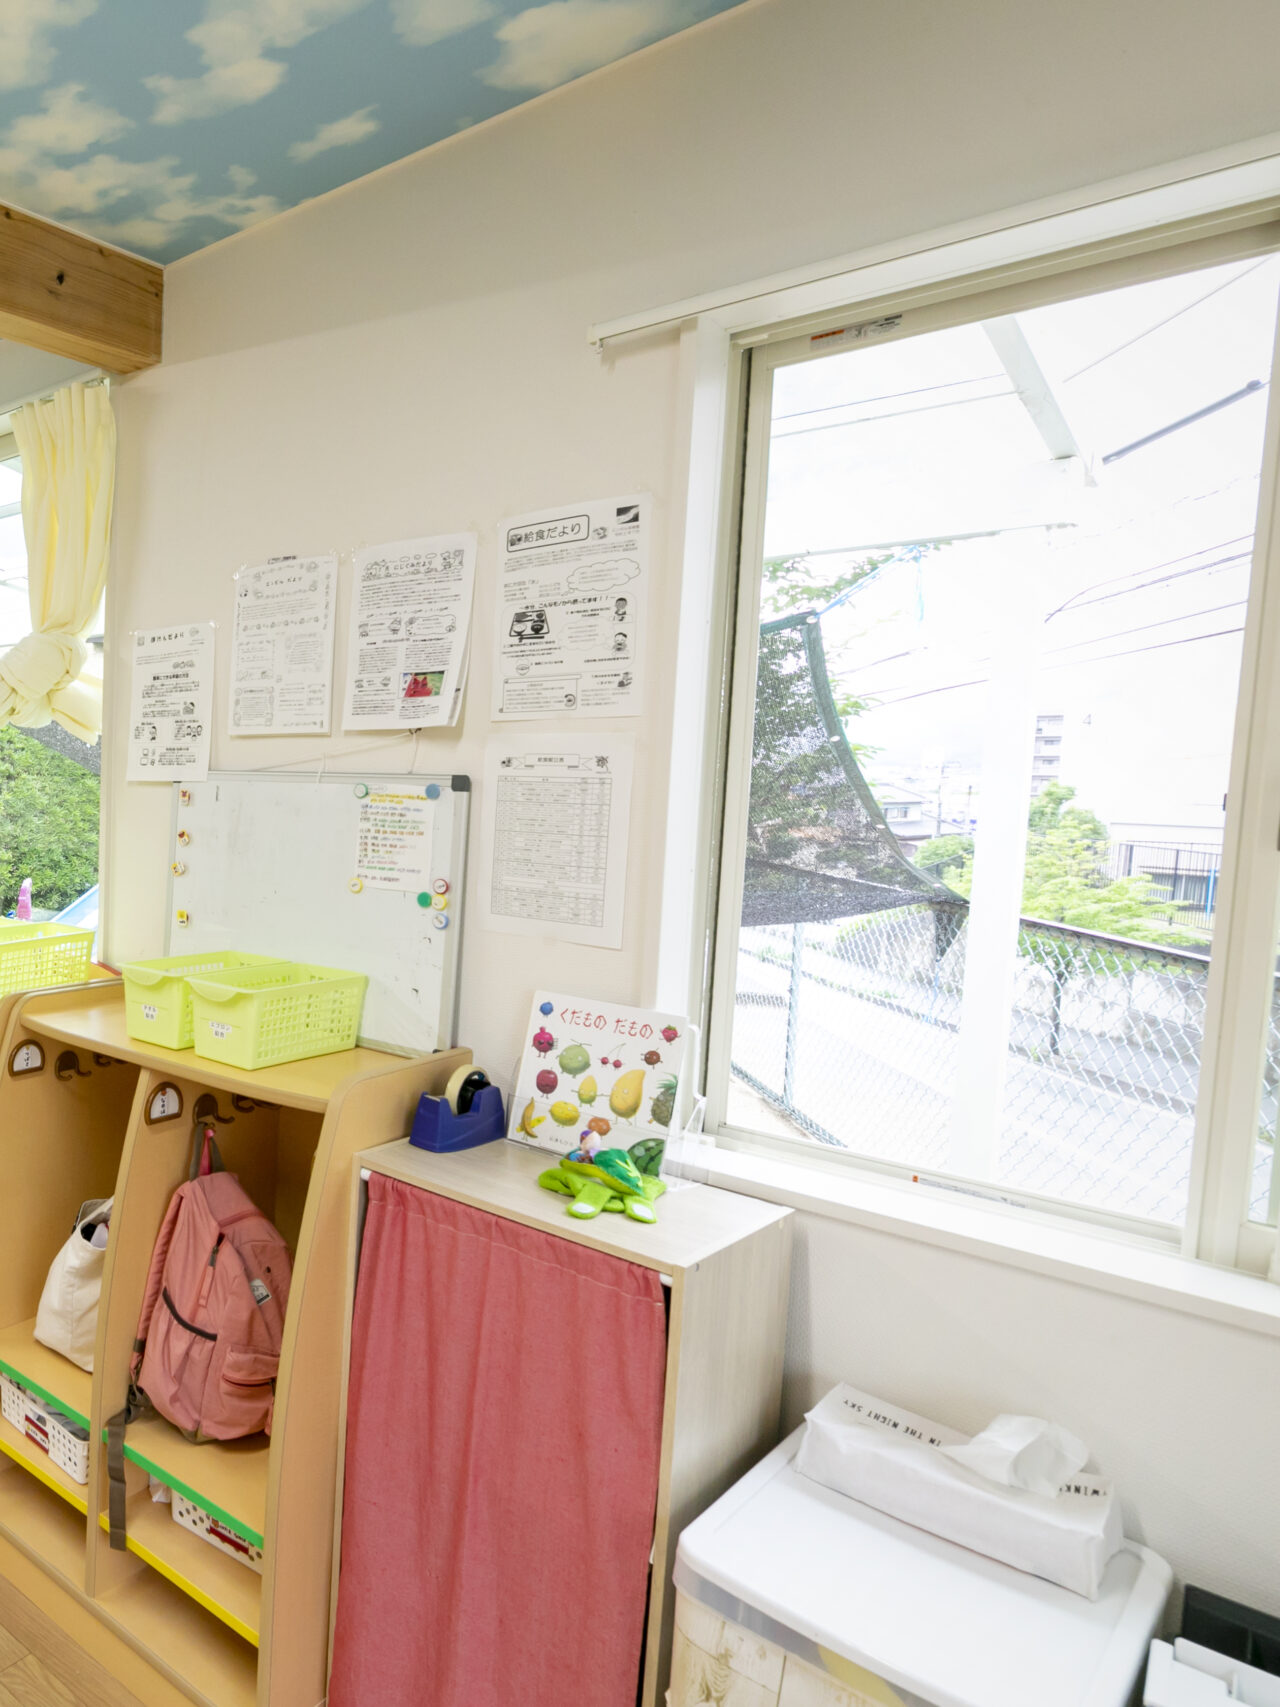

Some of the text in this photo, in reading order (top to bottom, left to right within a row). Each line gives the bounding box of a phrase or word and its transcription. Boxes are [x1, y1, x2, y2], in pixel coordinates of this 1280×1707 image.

[523, 523, 581, 543] 給食だより
[559, 1008, 654, 1040] くだもの だもの
[842, 1399, 942, 1447] IN THE NIGHT SKY
